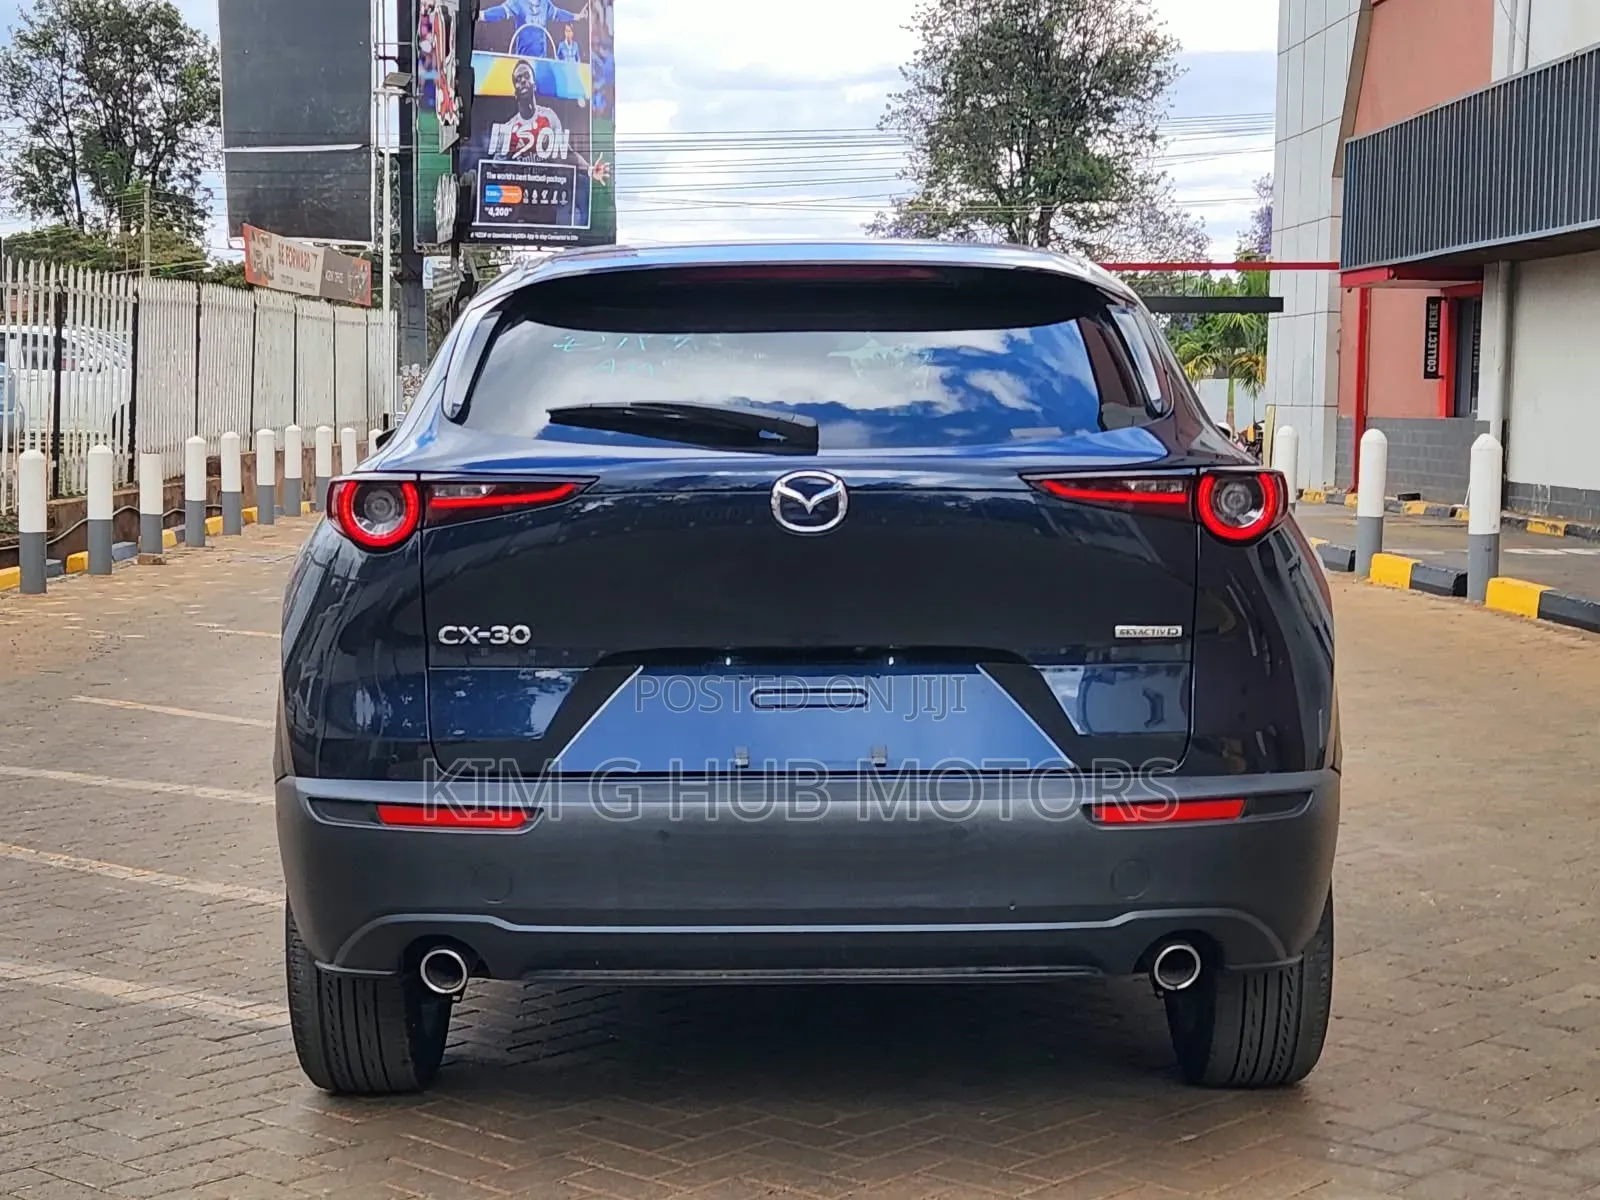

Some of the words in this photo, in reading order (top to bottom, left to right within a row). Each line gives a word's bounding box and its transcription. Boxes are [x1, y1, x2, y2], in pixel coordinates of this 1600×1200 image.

[536, 127, 570, 160] ON
[1428, 303, 1439, 329] HERE
[1427, 331, 1438, 372] COLLECT
[438, 625, 532, 645] CX-30
